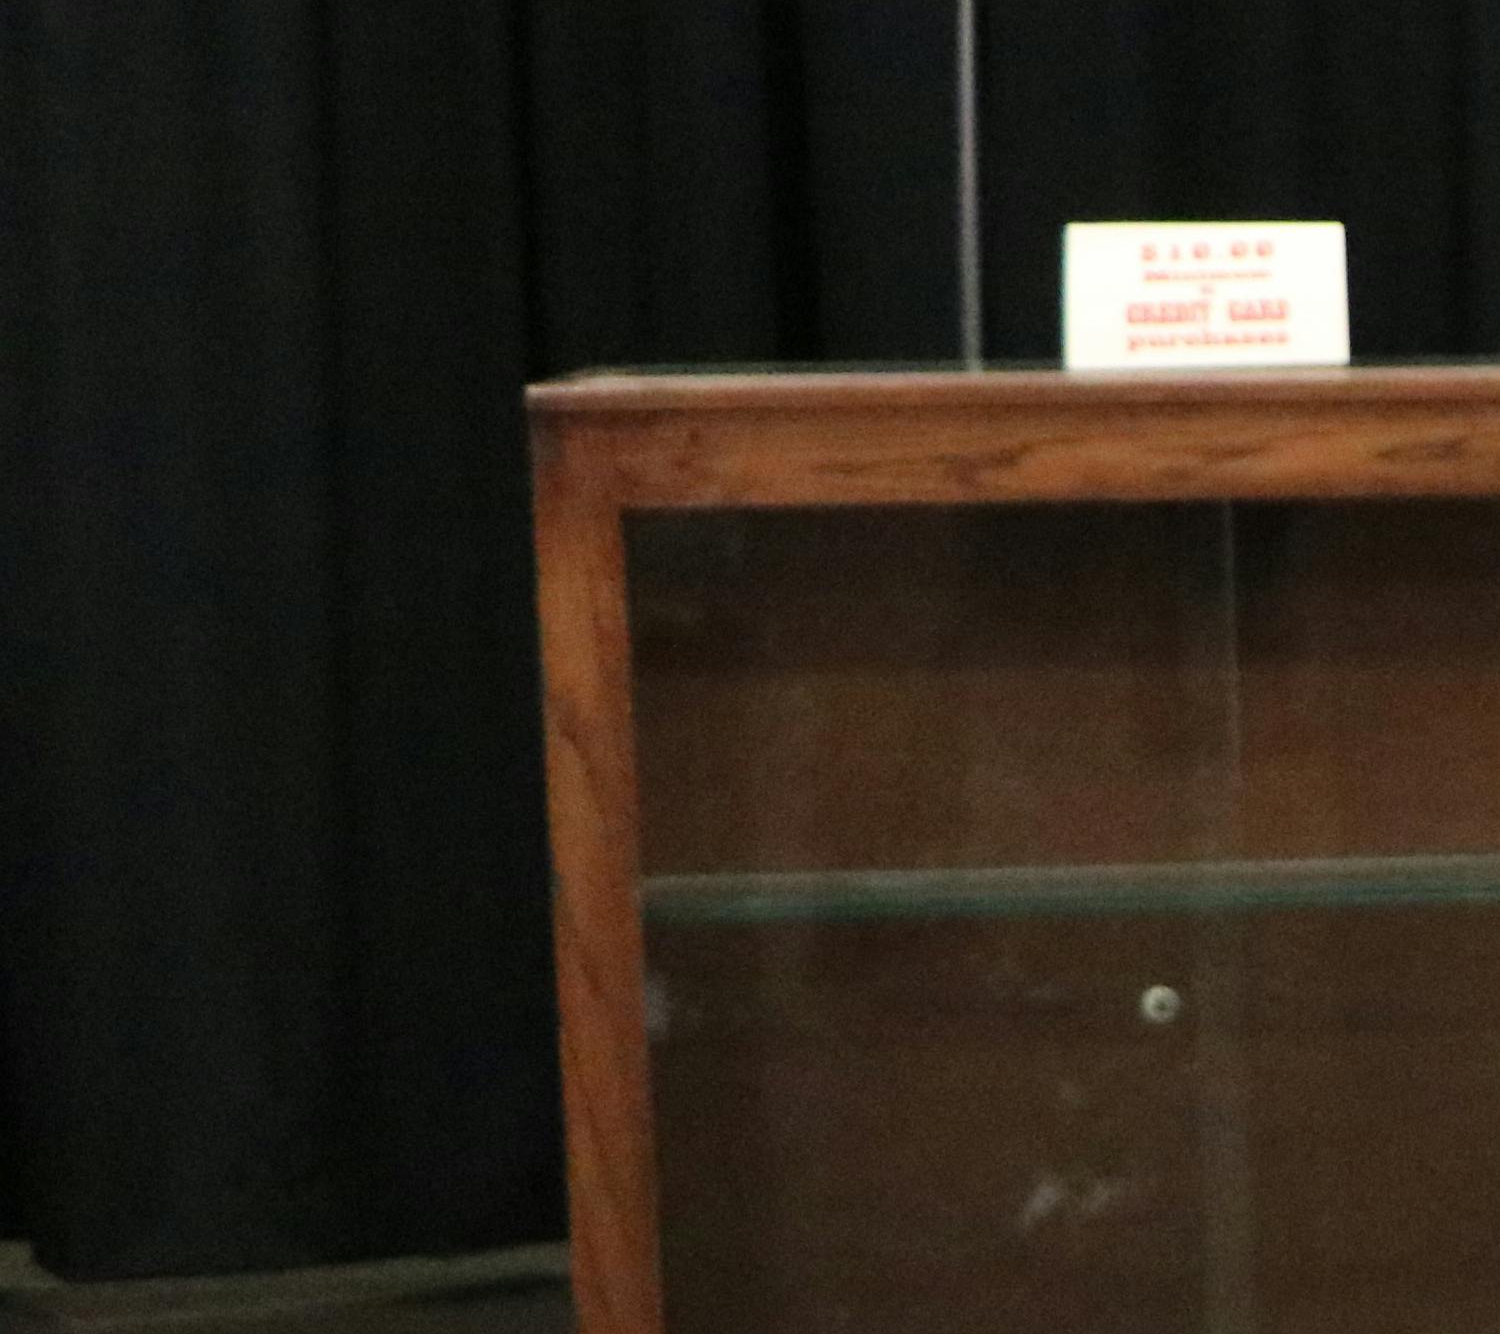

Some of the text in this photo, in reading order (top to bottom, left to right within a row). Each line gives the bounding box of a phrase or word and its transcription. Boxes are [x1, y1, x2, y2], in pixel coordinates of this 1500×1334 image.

[1126, 298, 1289, 325] CREDIT CARD
[1127, 330, 1290, 353] purchases
